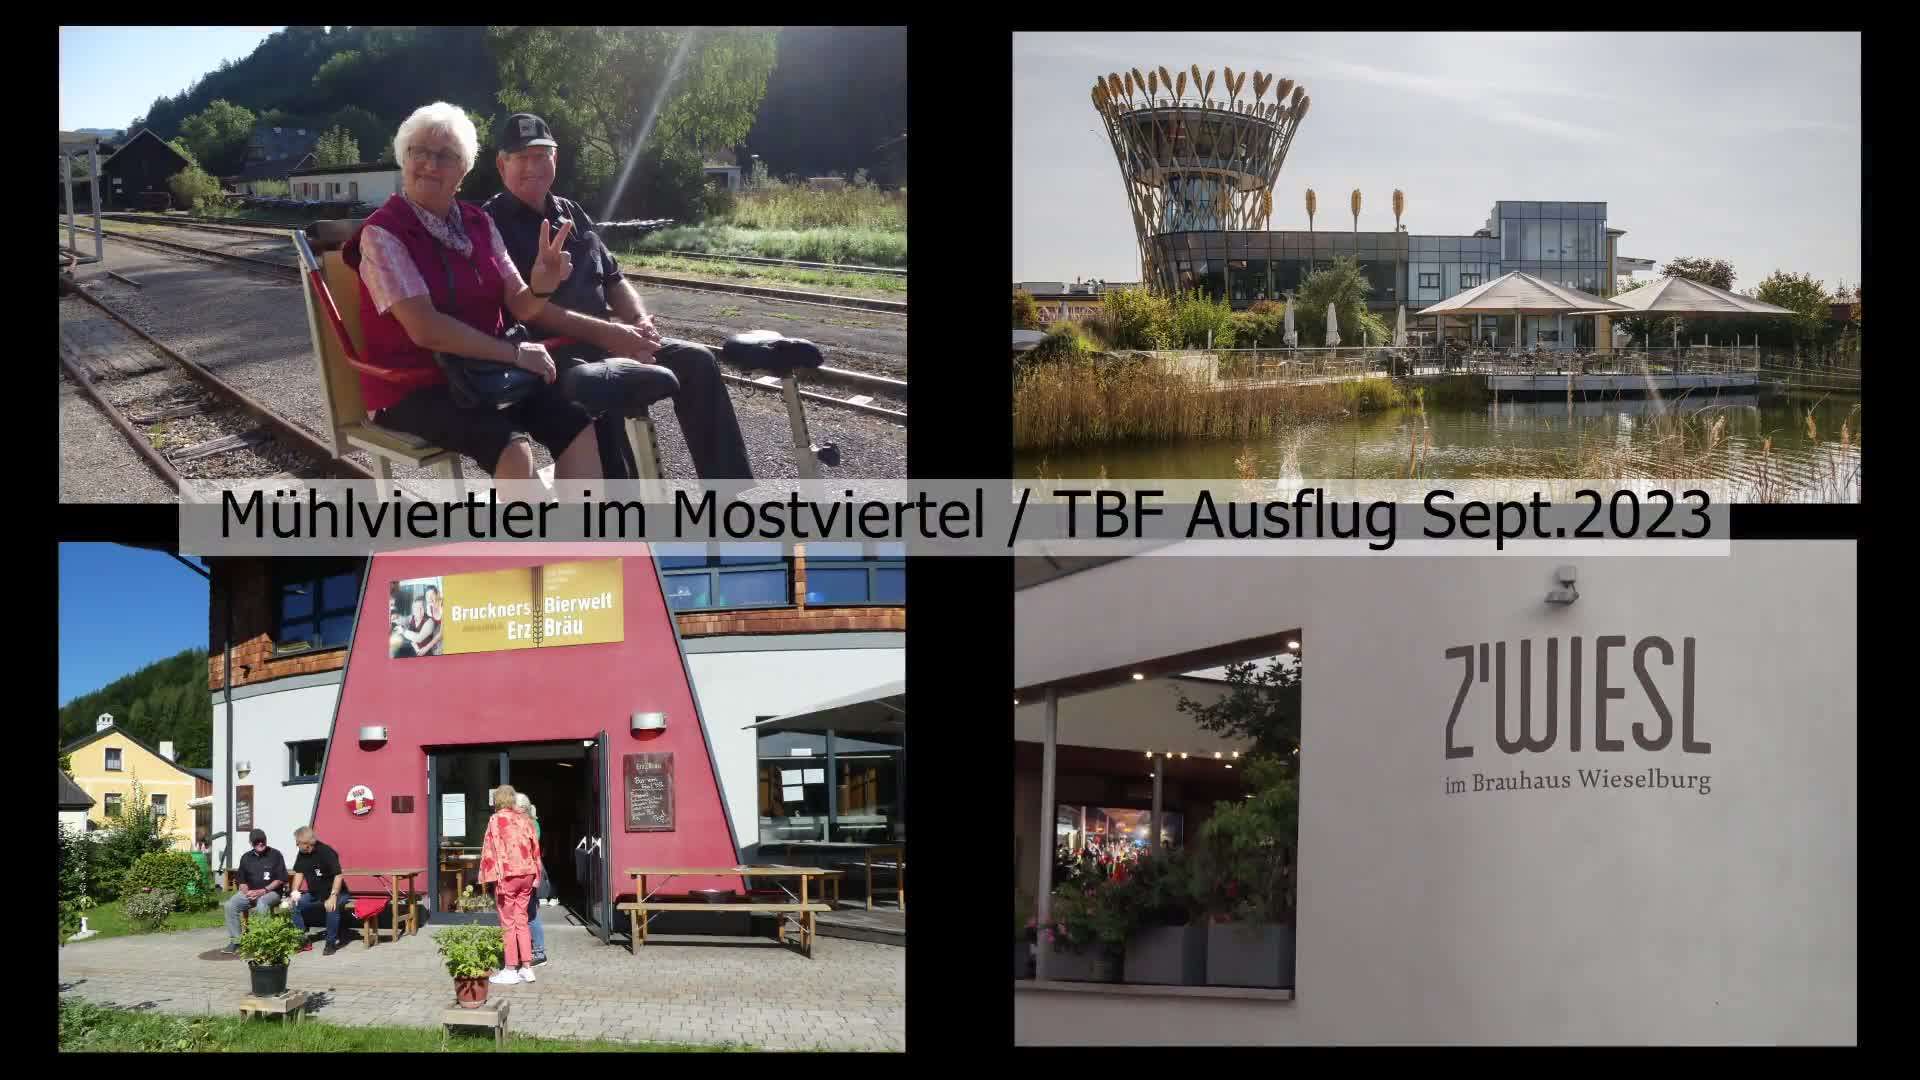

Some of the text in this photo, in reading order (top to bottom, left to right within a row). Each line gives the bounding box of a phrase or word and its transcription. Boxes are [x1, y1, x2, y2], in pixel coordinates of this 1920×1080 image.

[451, 592, 613, 621] Bruckners Bierwelt
[507, 621, 532, 640] Erz
[544, 616, 583, 637] Bräu
[1445, 635, 1712, 760] Z'WIESL
[1445, 767, 1712, 795] im Brauhaus Wieselburg
